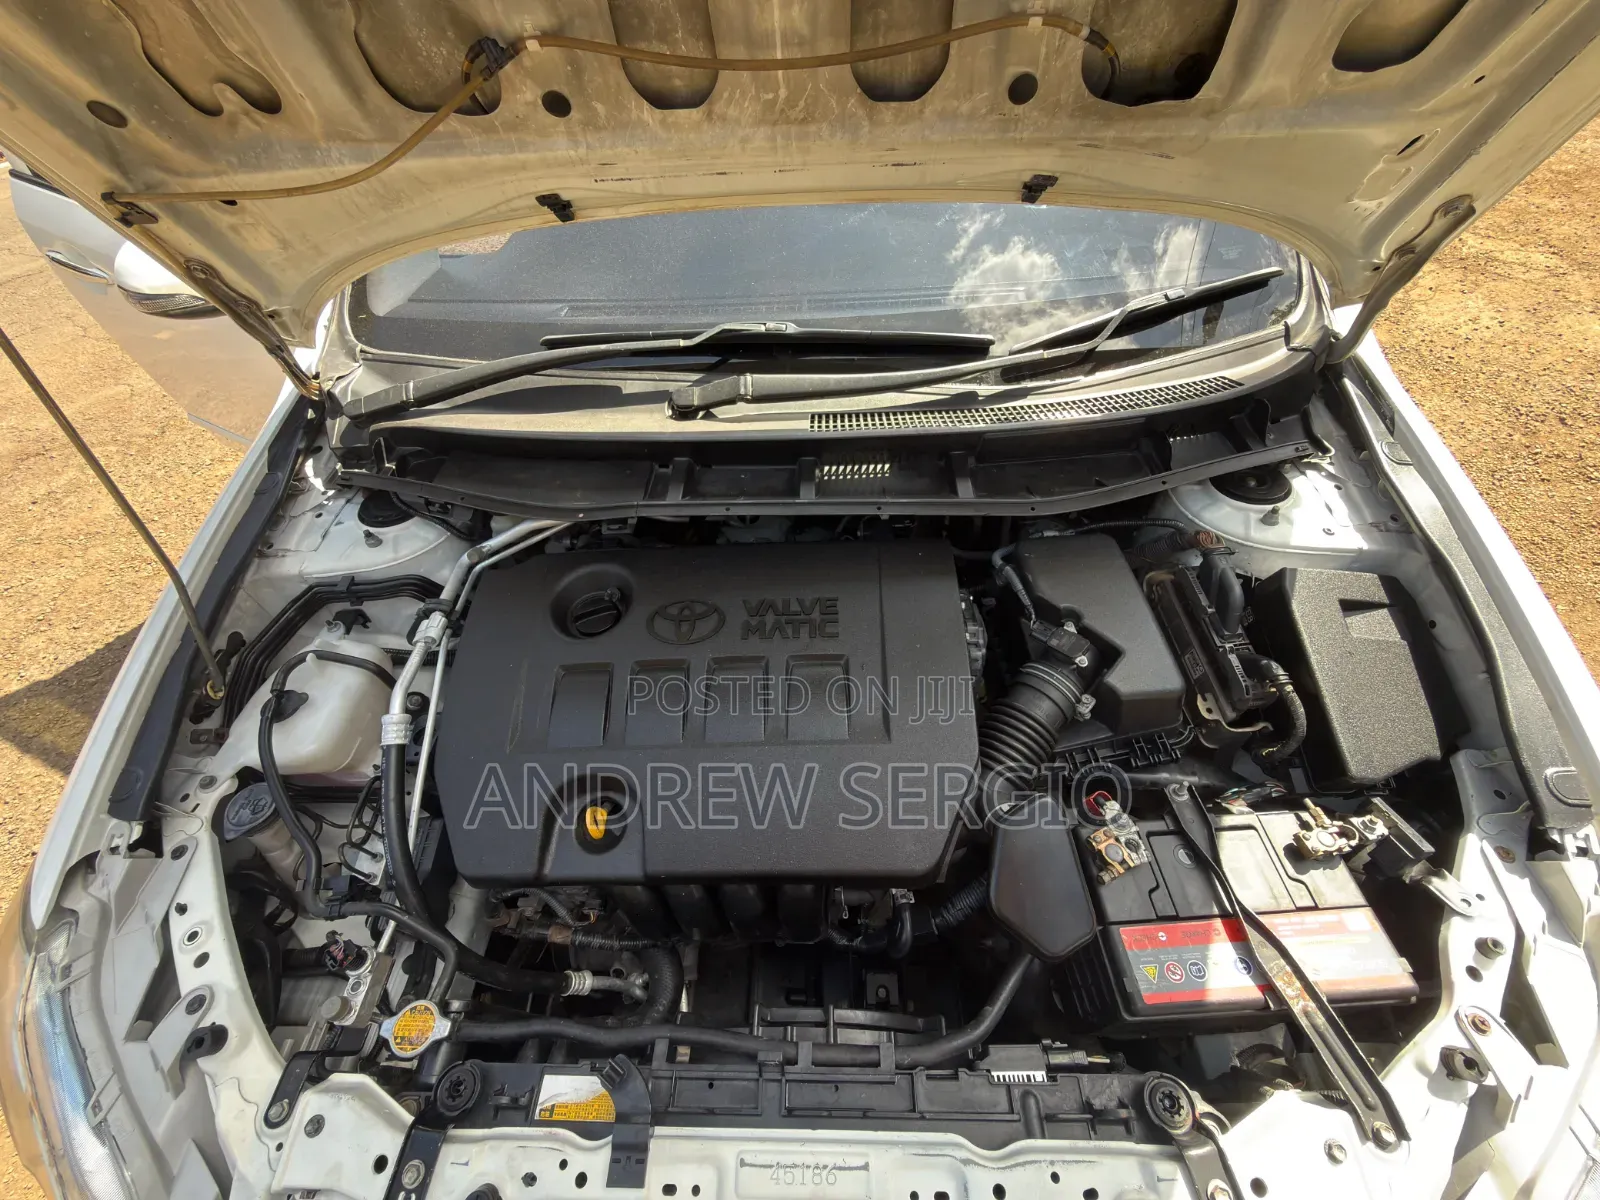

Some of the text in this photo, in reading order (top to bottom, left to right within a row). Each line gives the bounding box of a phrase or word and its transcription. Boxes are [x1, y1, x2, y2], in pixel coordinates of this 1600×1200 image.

[744, 598, 839, 618] VALVE
[741, 619, 839, 641] MATIC
[769, 1163, 838, 1186] 45186
